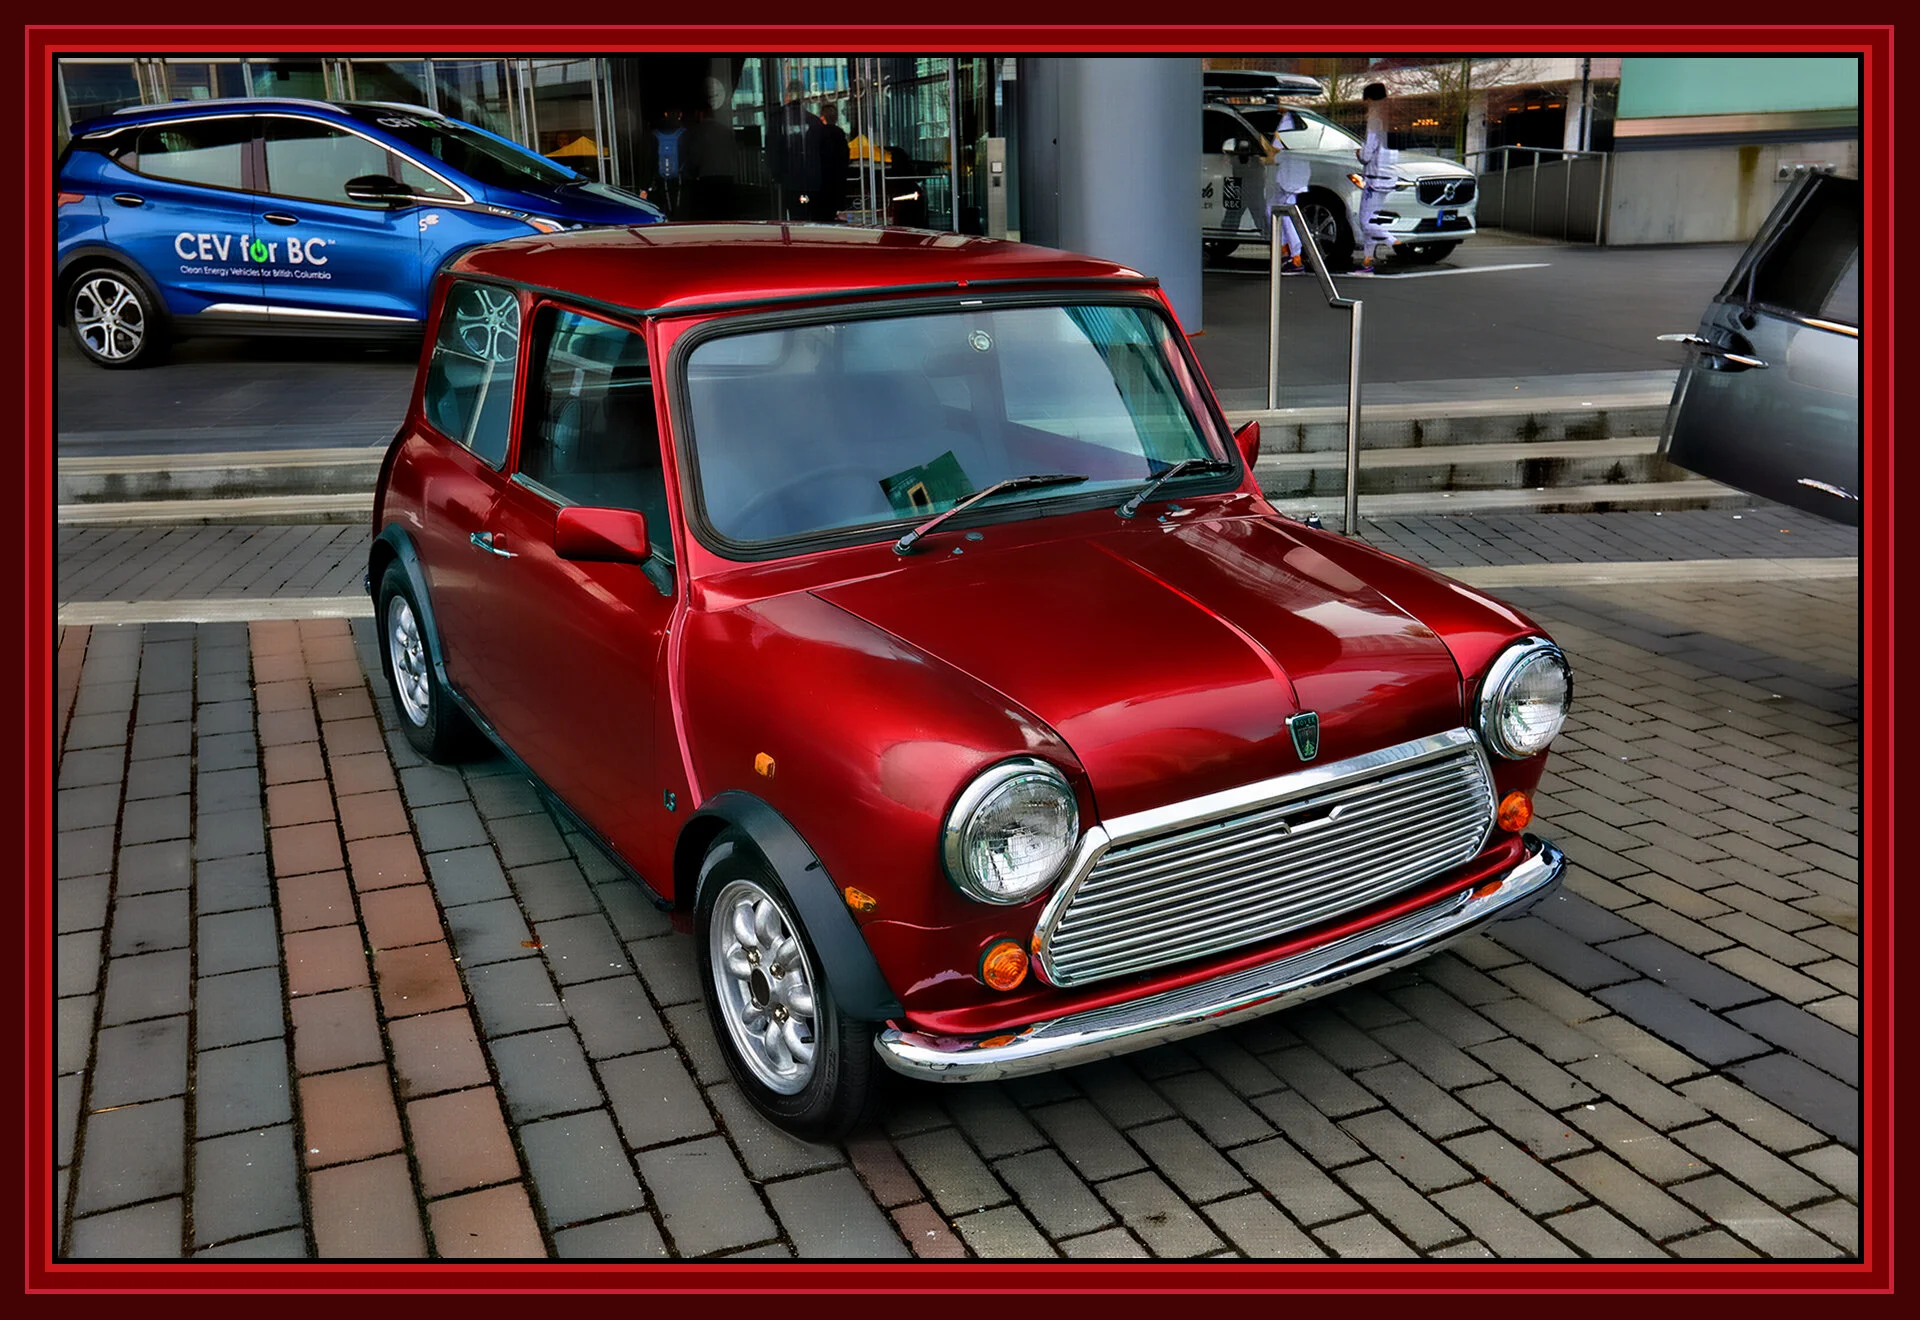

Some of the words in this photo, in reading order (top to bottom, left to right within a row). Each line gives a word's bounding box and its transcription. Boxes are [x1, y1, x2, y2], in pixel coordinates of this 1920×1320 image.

[174, 232, 232, 261] CEV
[240, 234, 278, 263] for
[180, 265, 203, 275] Clean
[203, 266, 230, 277] Energy
[230, 267, 260, 277] Vehicles
[261, 269, 272, 277] for
[272, 269, 293, 278] British
[294, 270, 332, 280] Columbia
